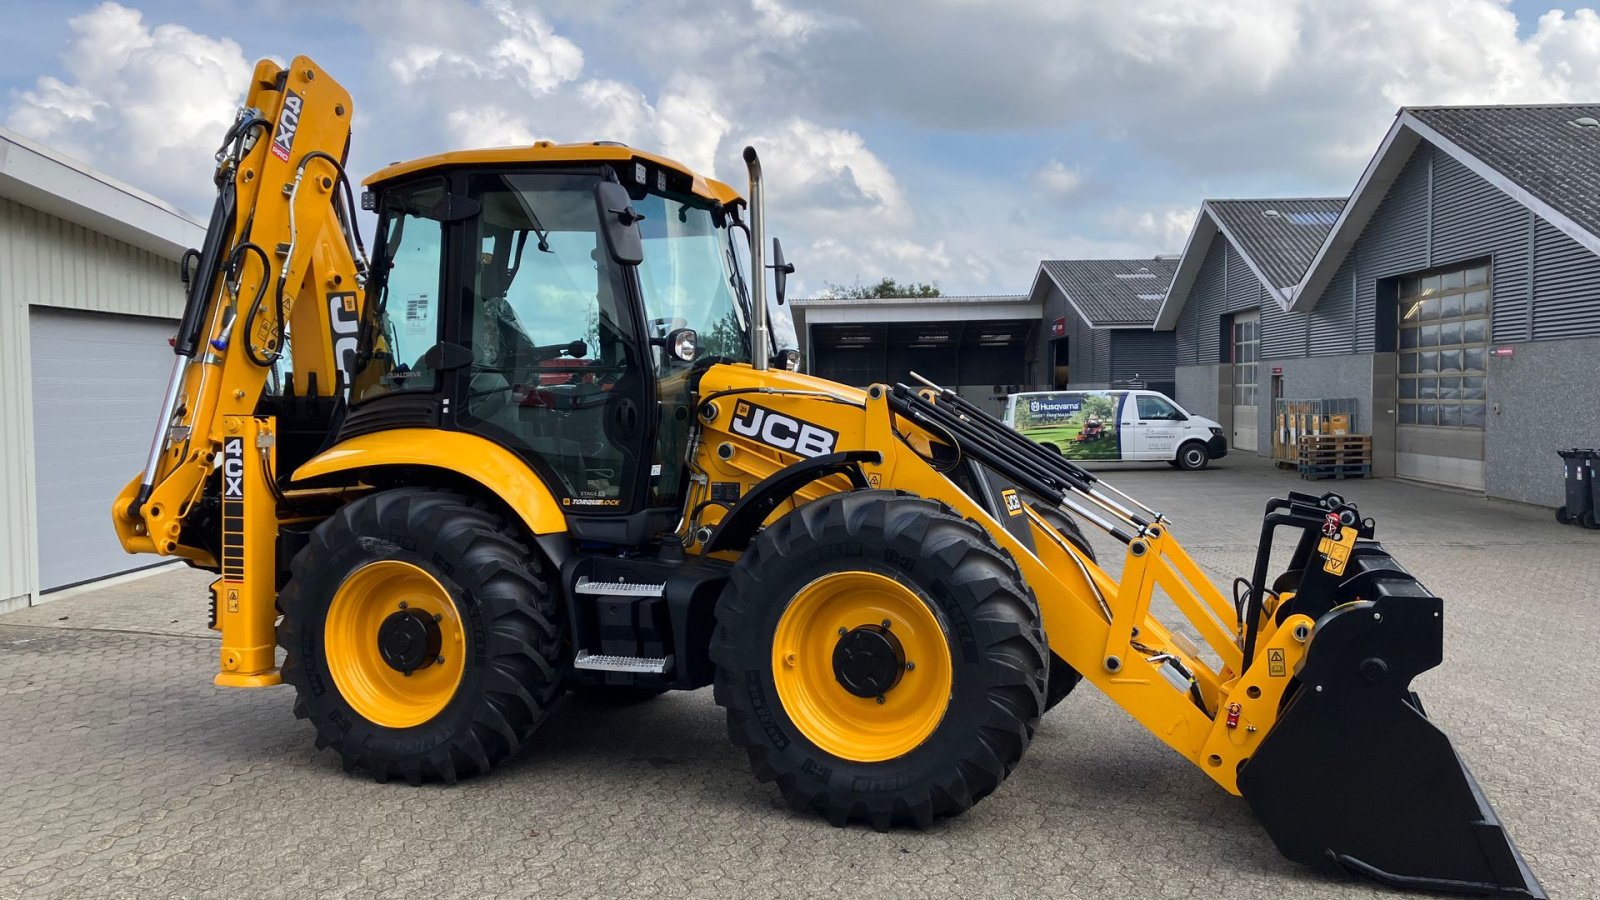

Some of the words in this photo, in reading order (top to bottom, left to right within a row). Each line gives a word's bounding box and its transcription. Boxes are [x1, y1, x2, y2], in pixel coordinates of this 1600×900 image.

[275, 96, 301, 150] 4CX
[272, 146, 289, 161] PRO
[1040, 403, 1079, 411] Husqvarna
[732, 408, 834, 458] JCB
[224, 438, 243, 496] 4CX
